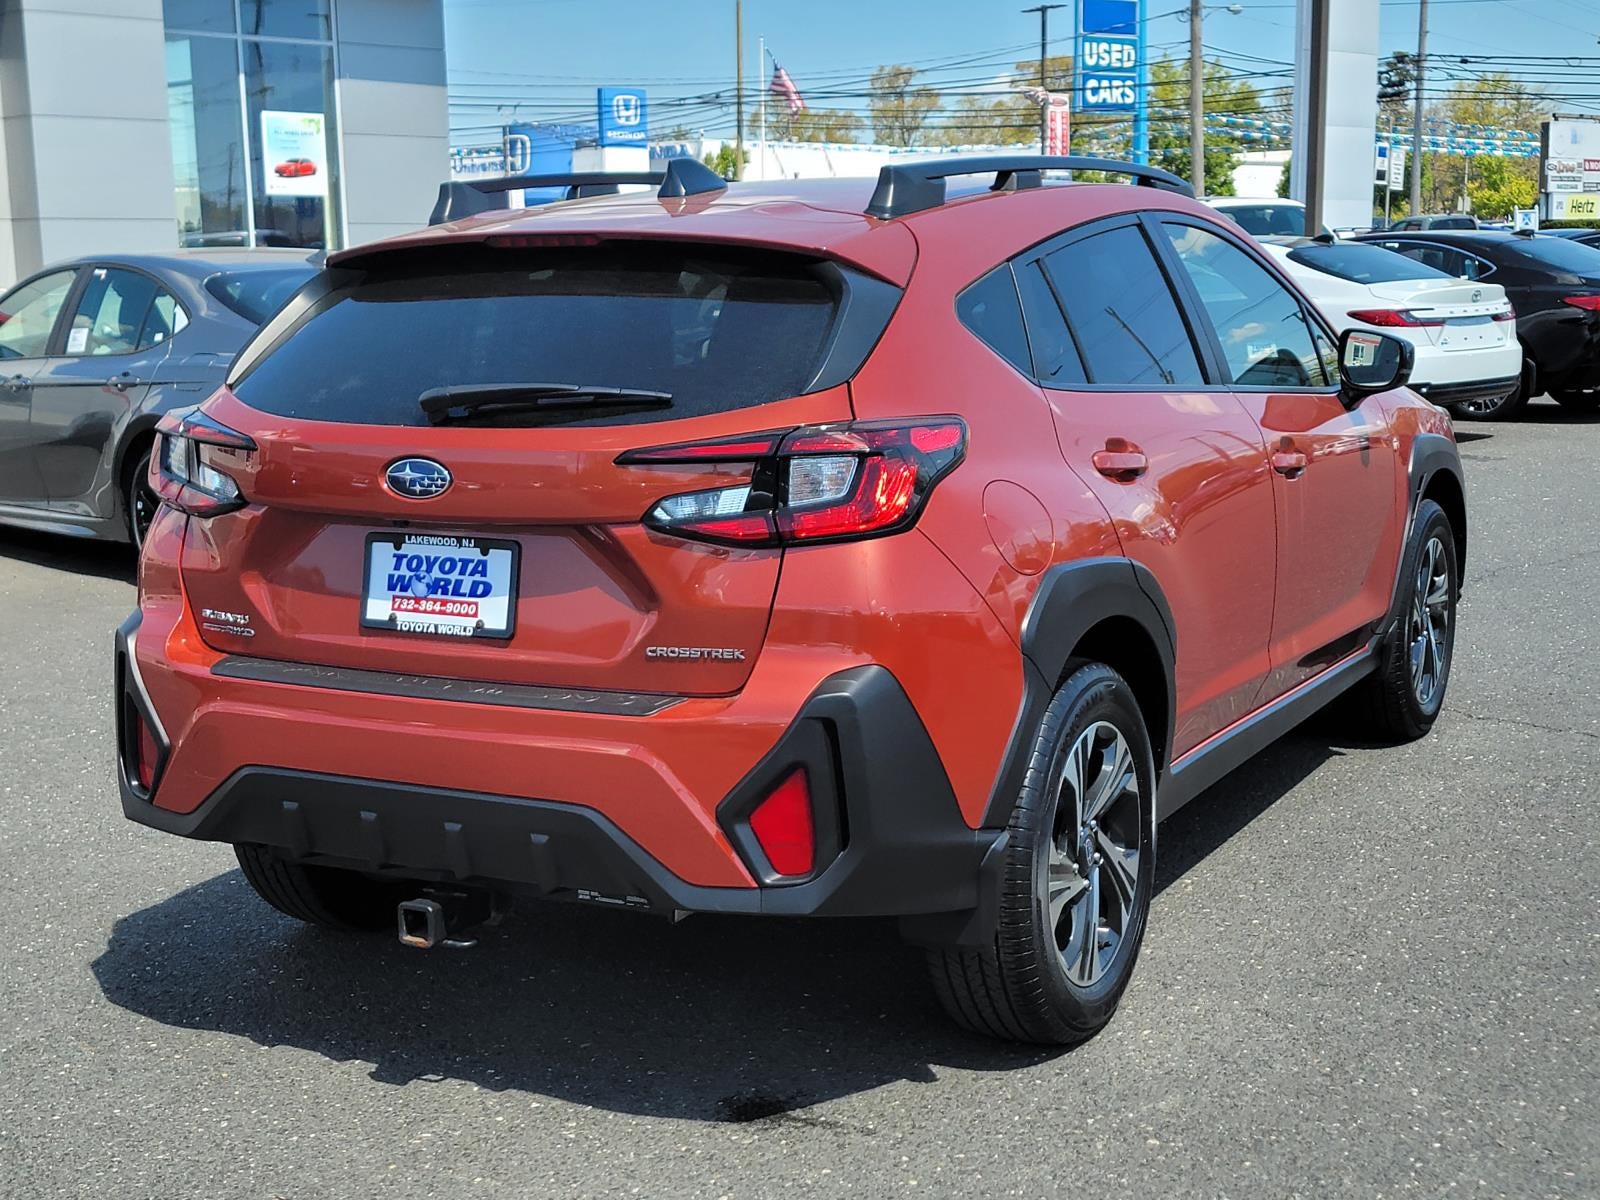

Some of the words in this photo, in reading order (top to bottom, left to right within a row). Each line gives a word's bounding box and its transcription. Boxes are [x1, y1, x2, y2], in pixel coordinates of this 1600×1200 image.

[1083, 41, 1136, 68] USED
[1085, 78, 1135, 104] CARS
[607, 130, 646, 139] HONDA
[1570, 199, 1596, 213] Hertz
[405, 535, 460, 549] LAKEWOOD,
[462, 538, 475, 548] NJ
[392, 553, 488, 577] TOYOTA
[393, 598, 477, 615] 732-364-9000
[396, 621, 436, 634] TOYOTA
[437, 624, 474, 636] WORLD
[646, 646, 745, 660] CROSSTREK
